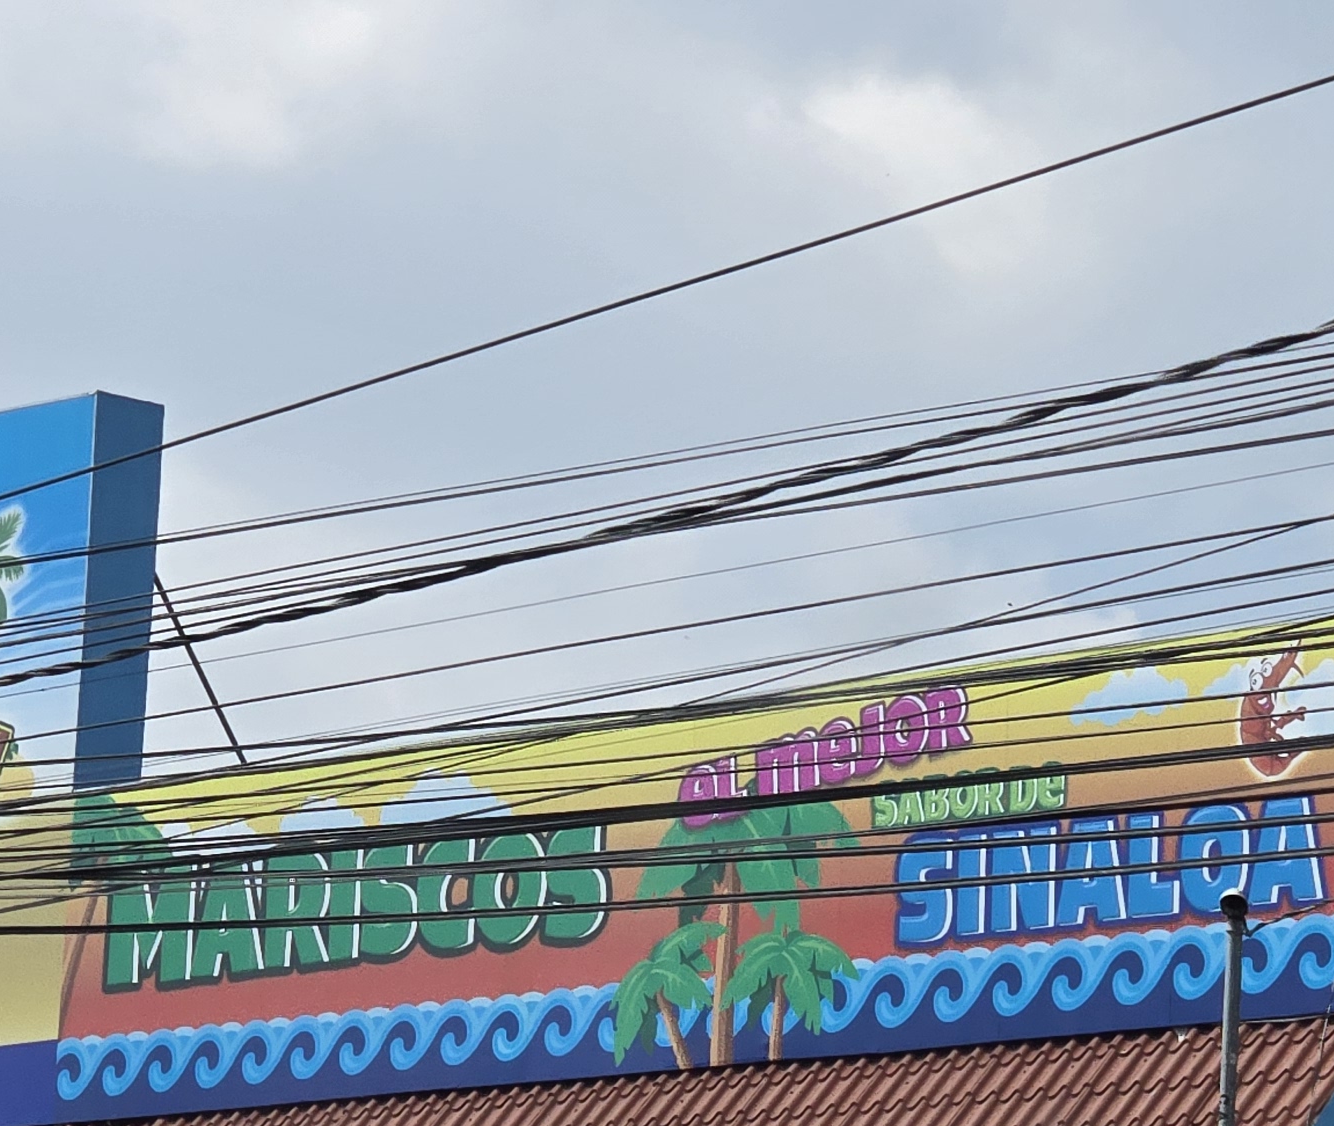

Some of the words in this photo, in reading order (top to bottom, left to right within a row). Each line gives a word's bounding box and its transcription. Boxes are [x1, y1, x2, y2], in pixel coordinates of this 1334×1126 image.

[871, 768, 1007, 829] SABOR
[894, 793, 1331, 947] SINALOA
[103, 824, 611, 994] MARISCOS
